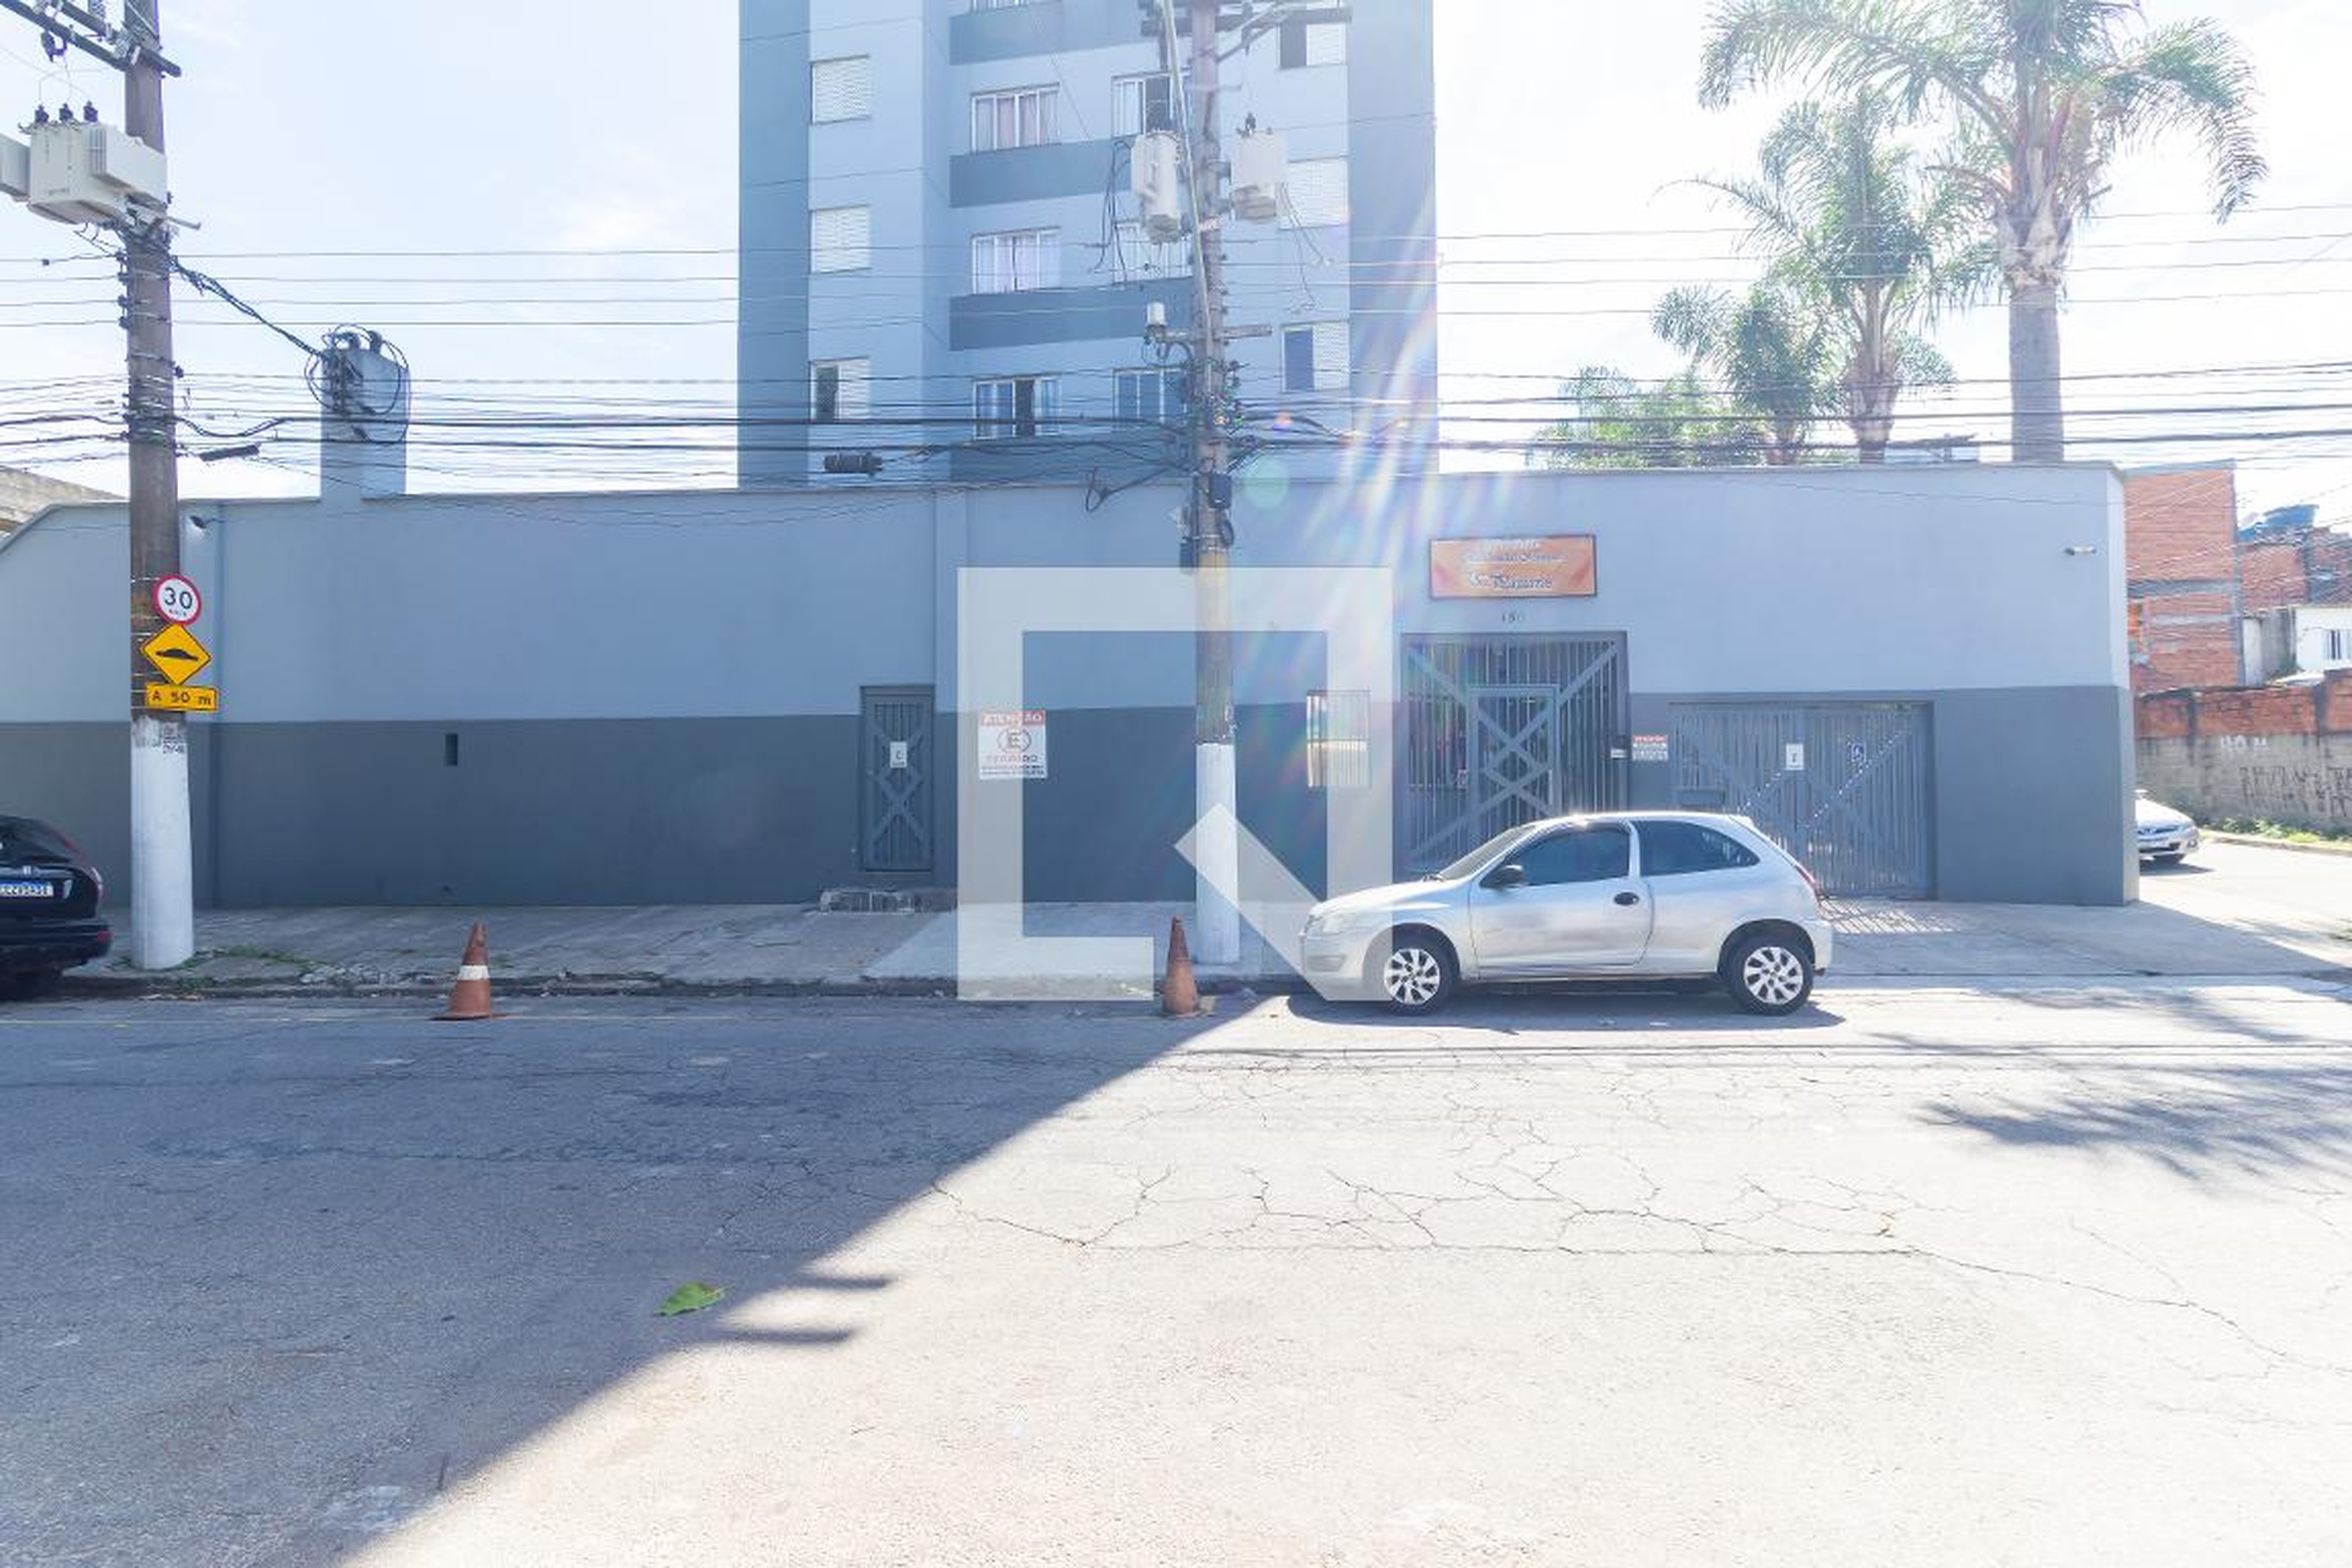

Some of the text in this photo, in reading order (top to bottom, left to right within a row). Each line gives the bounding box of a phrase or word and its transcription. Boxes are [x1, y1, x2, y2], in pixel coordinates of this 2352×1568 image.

[164, 587, 192, 609] 30
[151, 691, 212, 706] A 50 m
